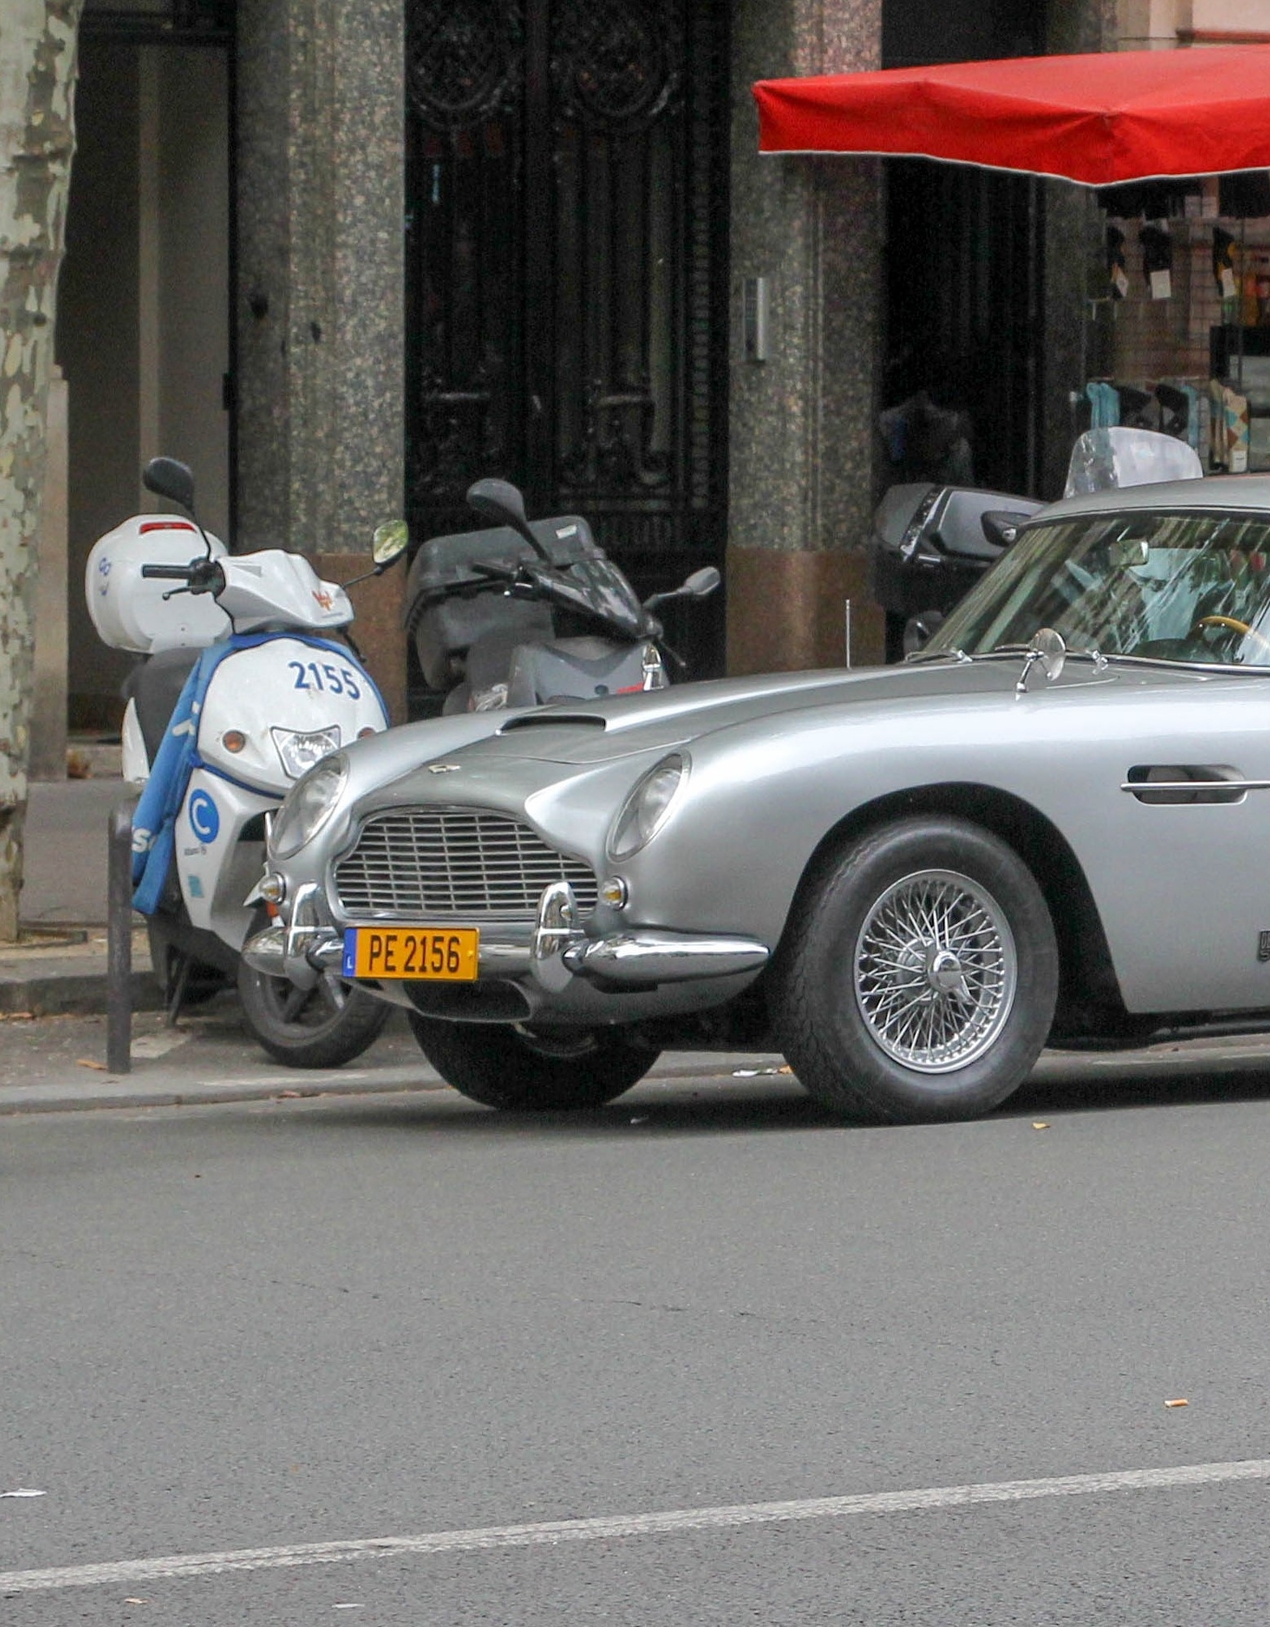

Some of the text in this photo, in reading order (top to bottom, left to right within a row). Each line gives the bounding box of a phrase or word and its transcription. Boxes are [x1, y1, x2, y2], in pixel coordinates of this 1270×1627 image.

[288, 661, 361, 700] 2155
[369, 934, 460, 973] PE 2156
